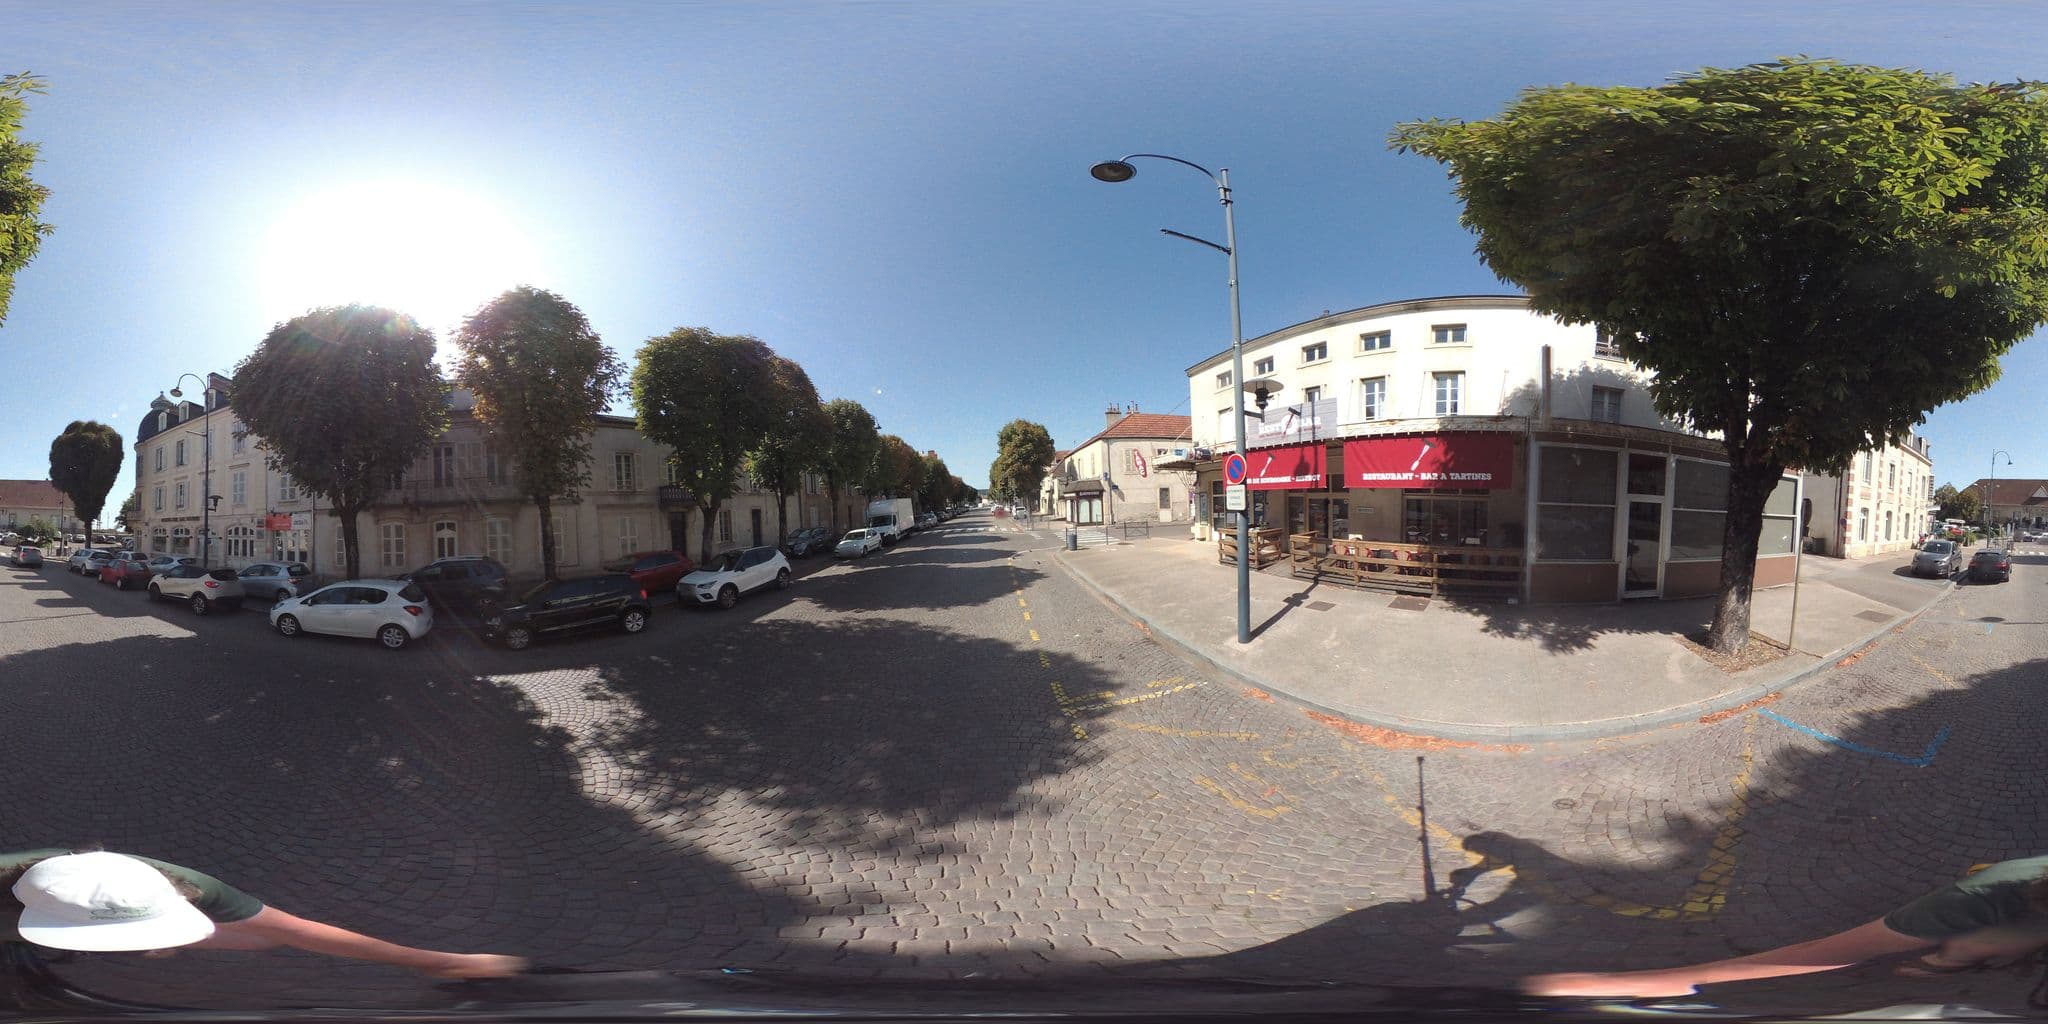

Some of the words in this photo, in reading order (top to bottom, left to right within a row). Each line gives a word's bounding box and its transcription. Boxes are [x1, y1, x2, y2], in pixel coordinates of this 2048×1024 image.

[1362, 472, 1414, 481] RESTAURANT
[1420, 472, 1438, 481] BAR
[1449, 472, 1493, 481] TARTINES
